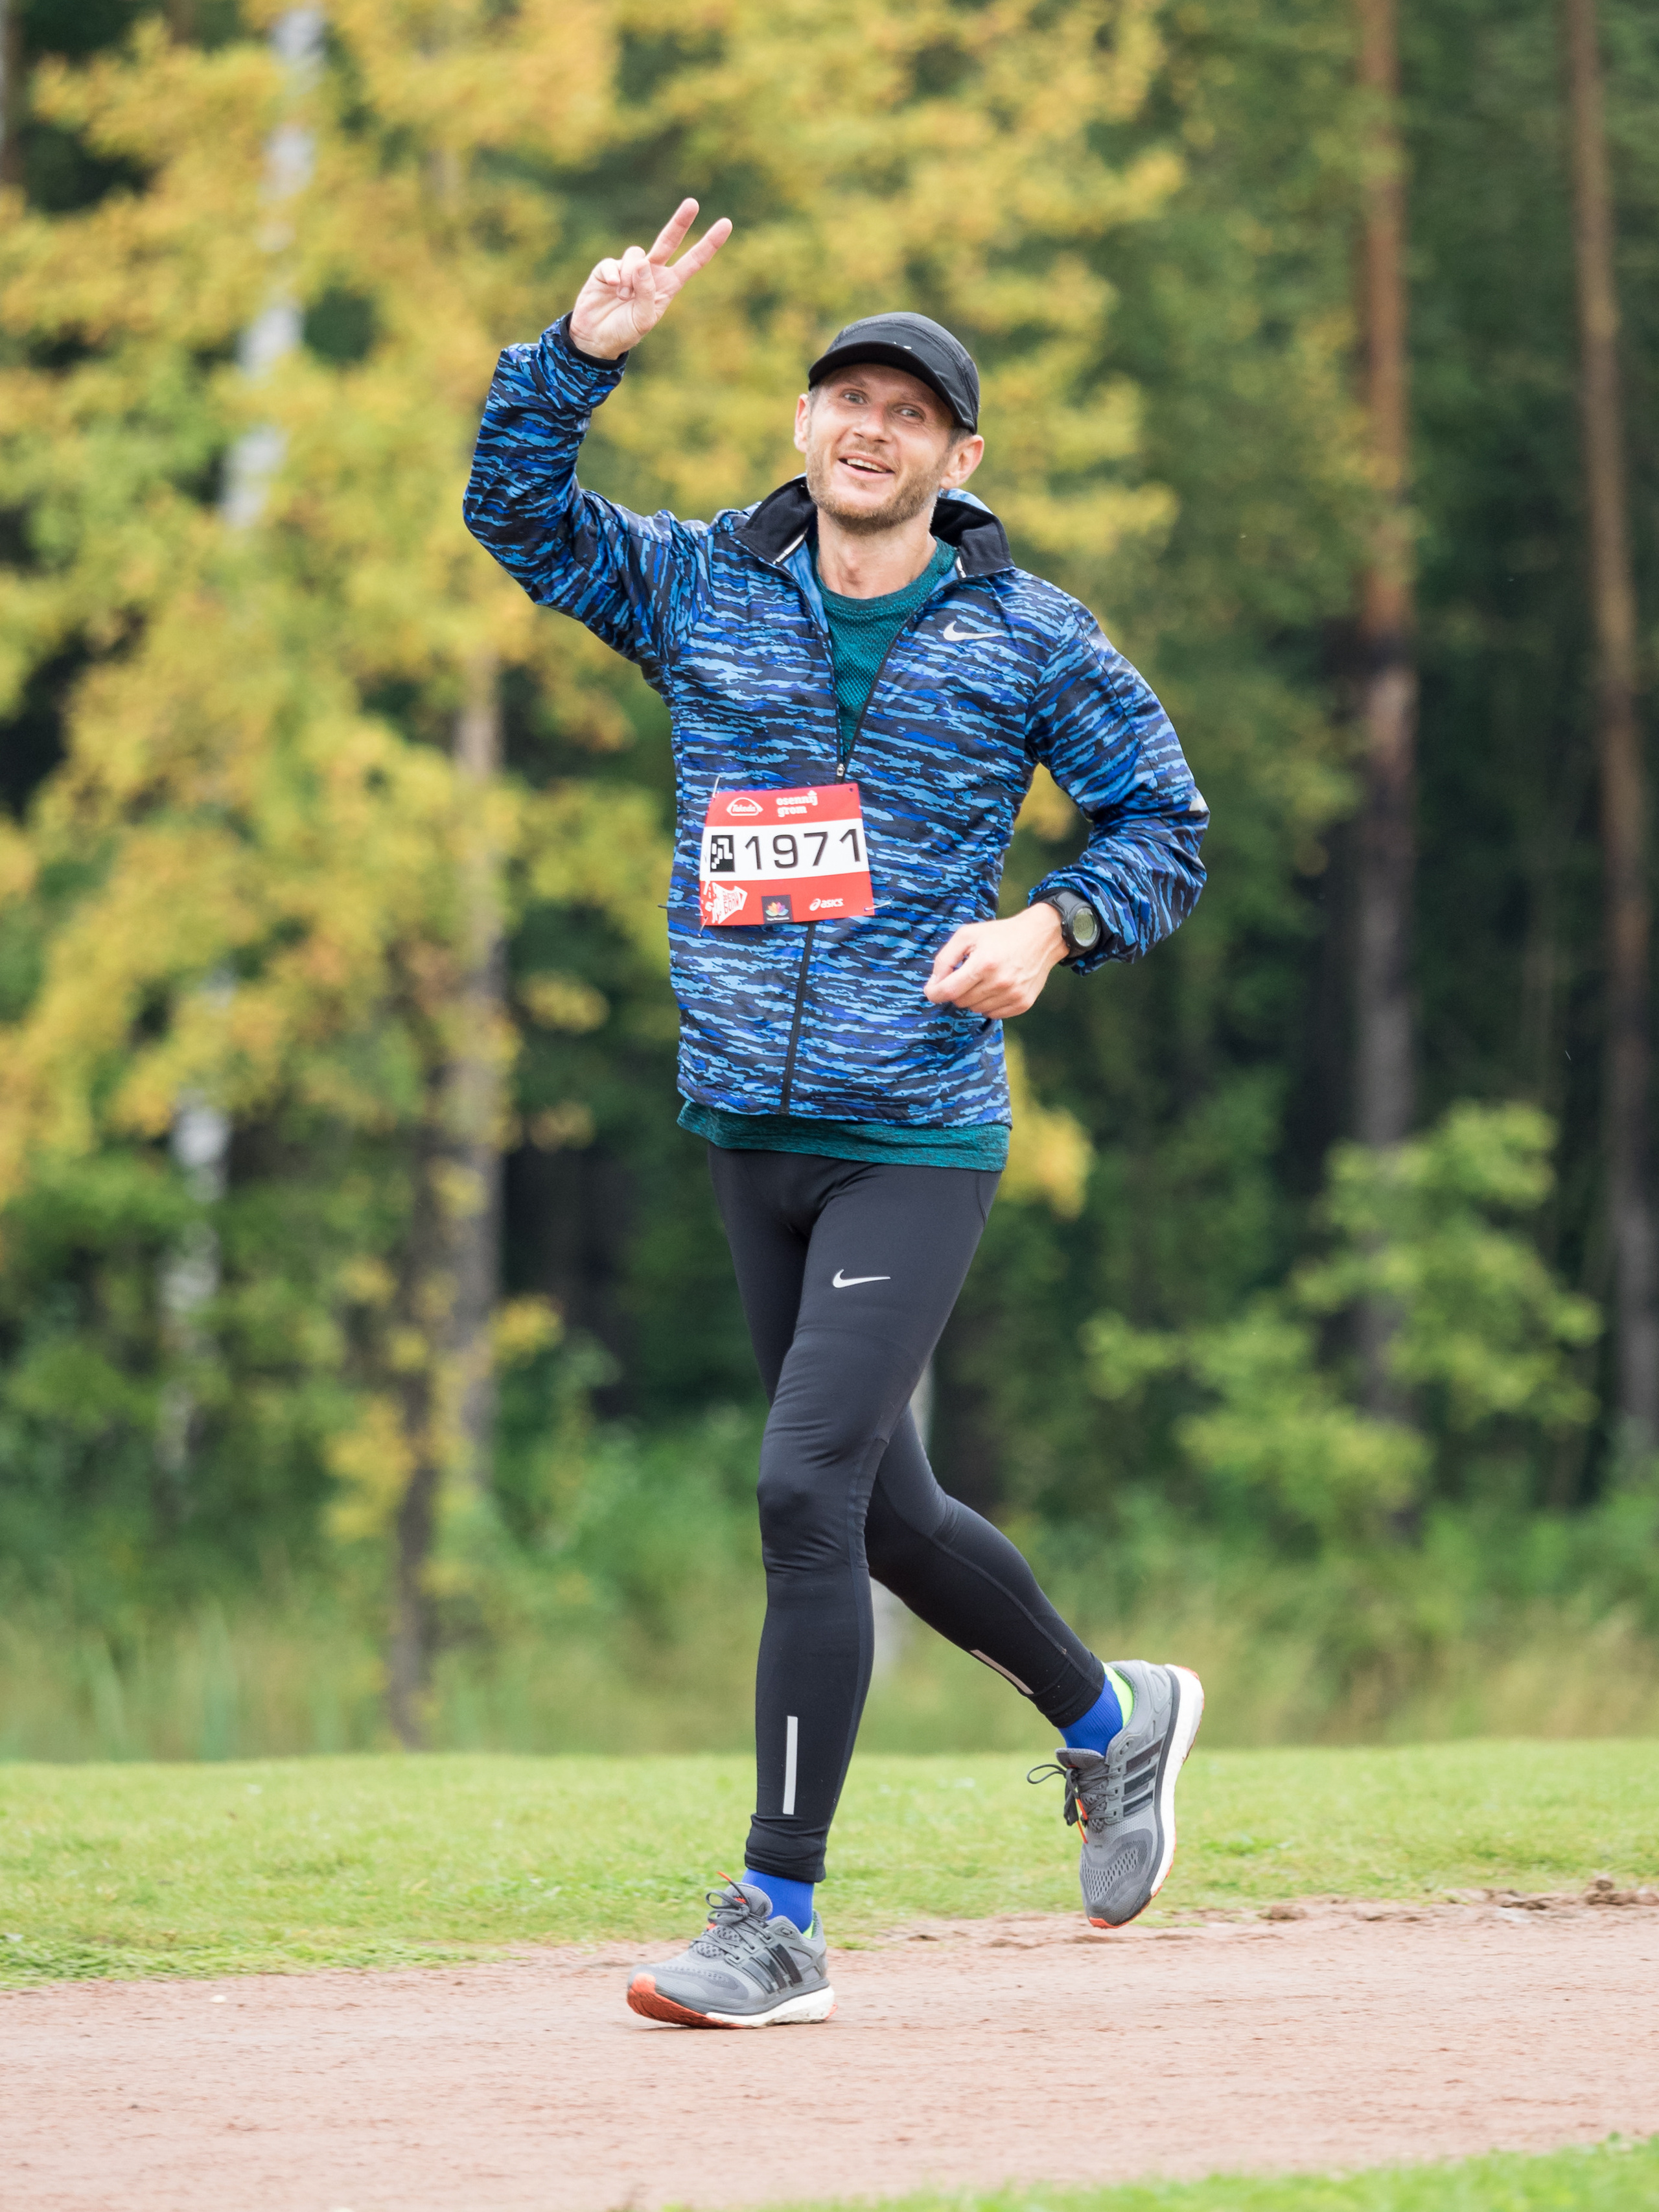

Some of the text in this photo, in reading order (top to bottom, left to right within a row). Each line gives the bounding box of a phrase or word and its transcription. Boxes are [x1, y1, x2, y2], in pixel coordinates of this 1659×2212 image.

[778, 806, 807, 817] grom
[745, 829, 861, 870] 1971
[820, 898, 844, 908] asics
